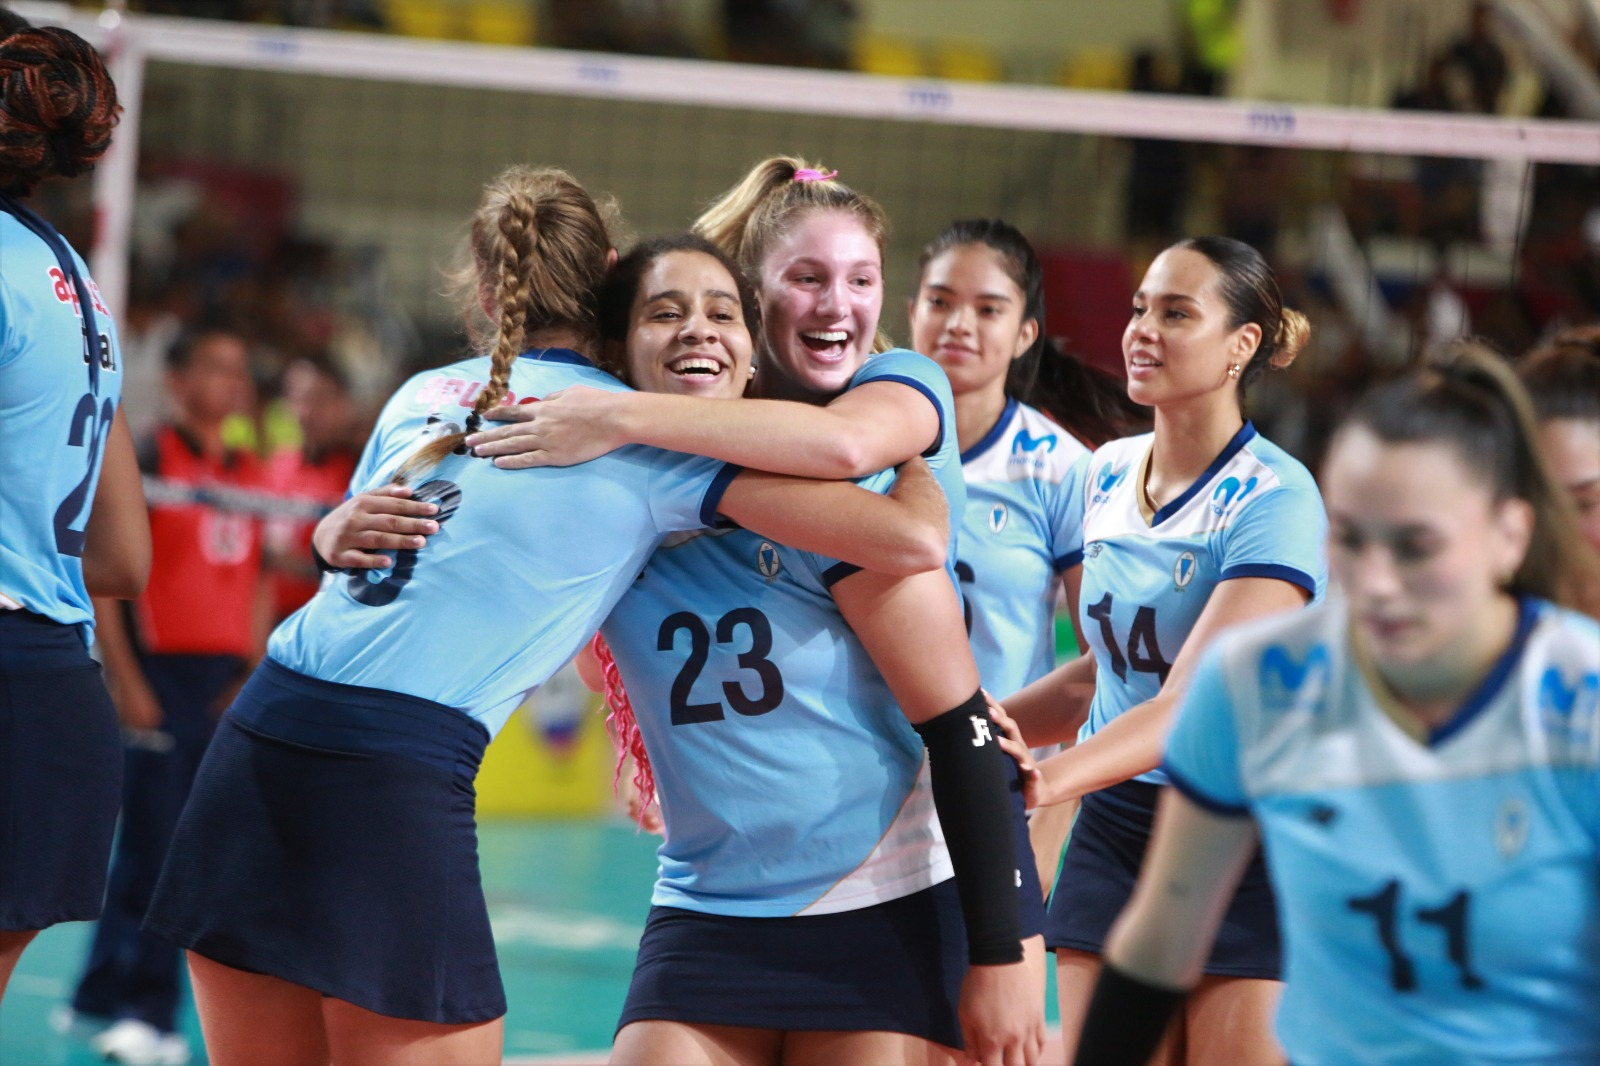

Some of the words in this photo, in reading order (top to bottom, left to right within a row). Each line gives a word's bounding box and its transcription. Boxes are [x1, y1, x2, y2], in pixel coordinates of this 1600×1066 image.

[657, 607, 784, 726] 23
[1087, 591, 1173, 688] 14
[1348, 878, 1486, 994] 11
